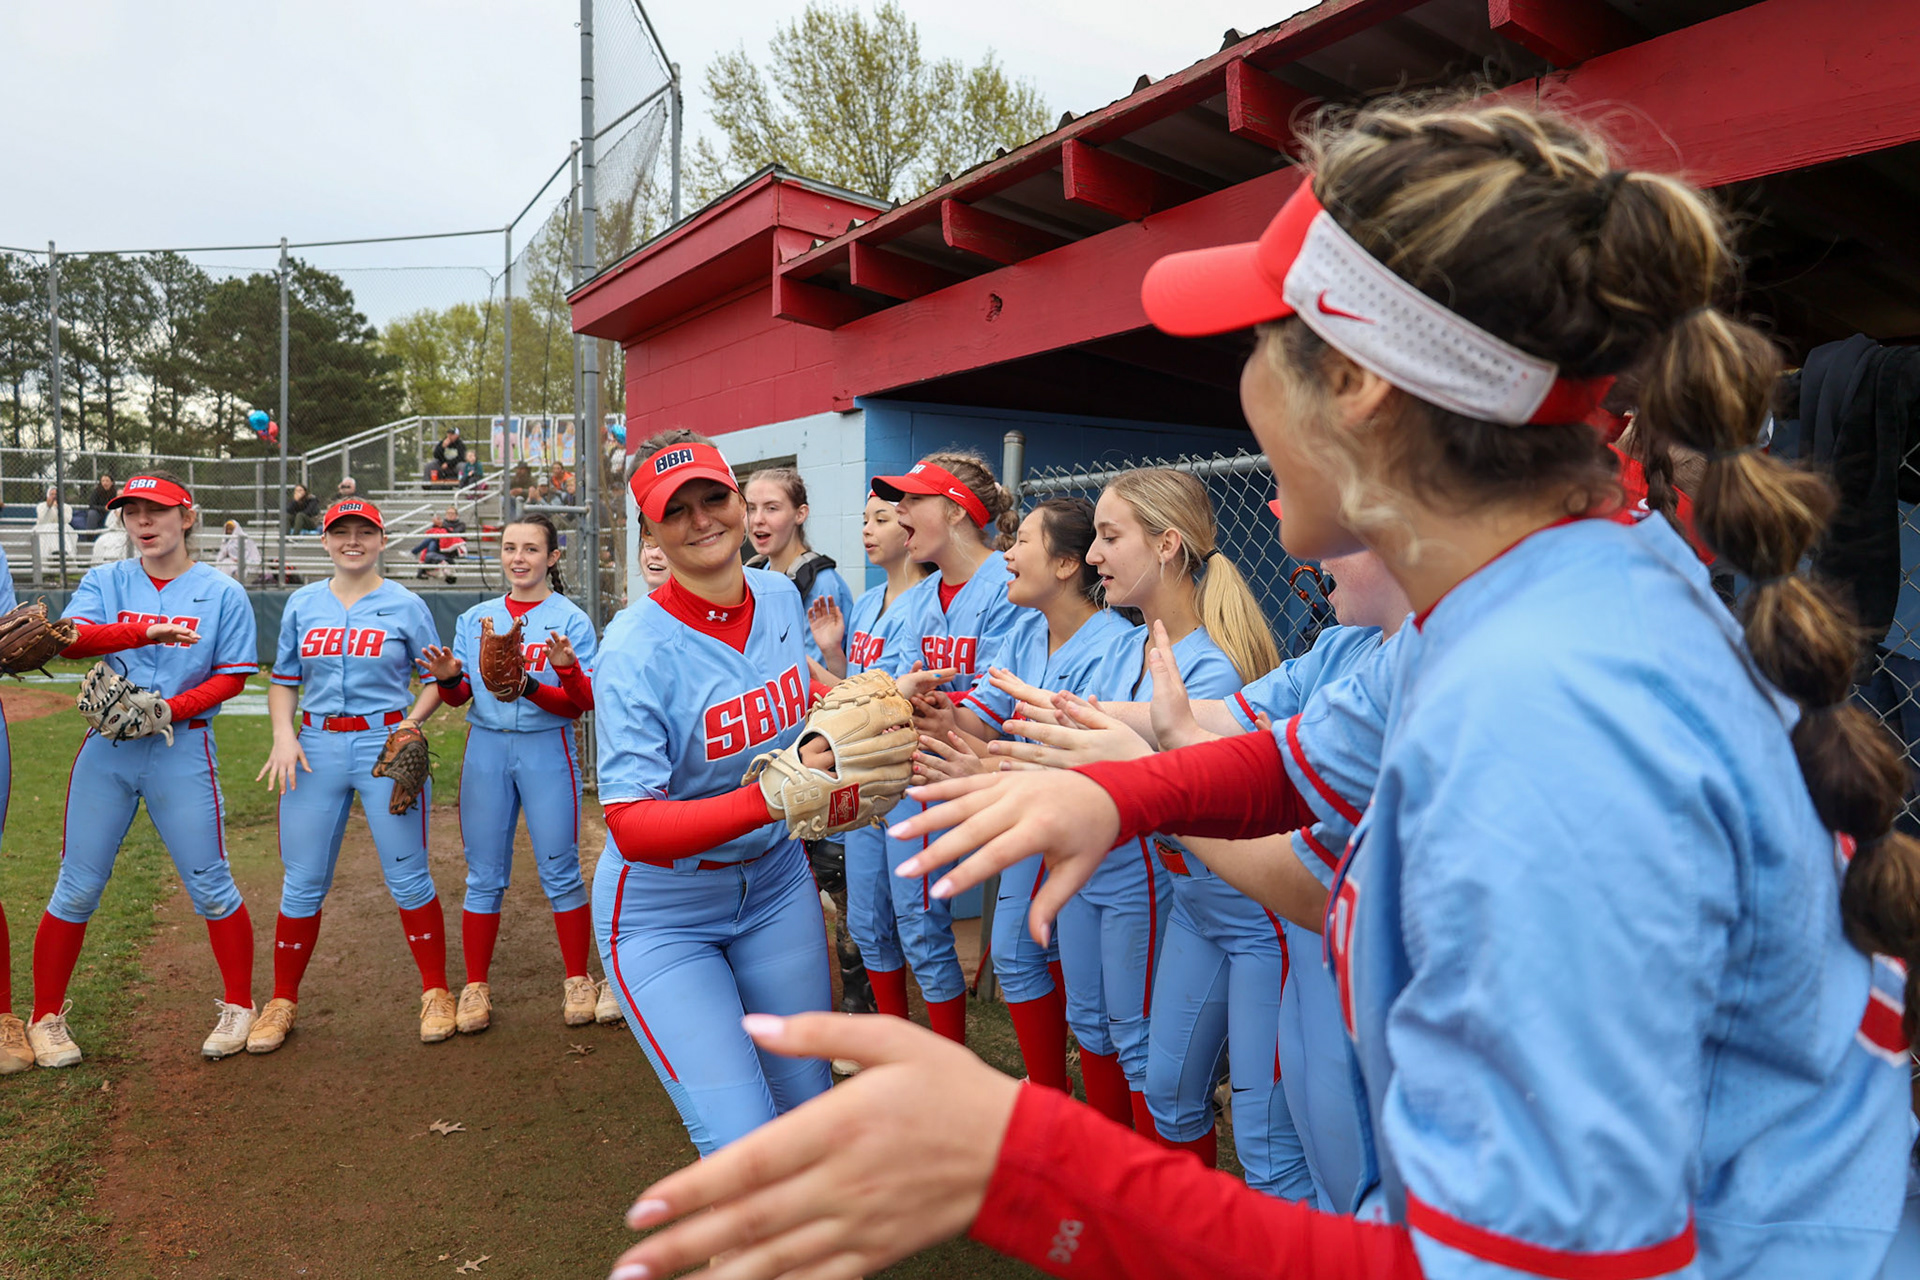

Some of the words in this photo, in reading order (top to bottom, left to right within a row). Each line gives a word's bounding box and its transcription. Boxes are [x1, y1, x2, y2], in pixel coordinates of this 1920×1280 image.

[129, 478, 157, 490] SBA
[301, 627, 387, 658] SBA
[921, 635, 978, 675] SBA
[703, 663, 806, 762] SBA
